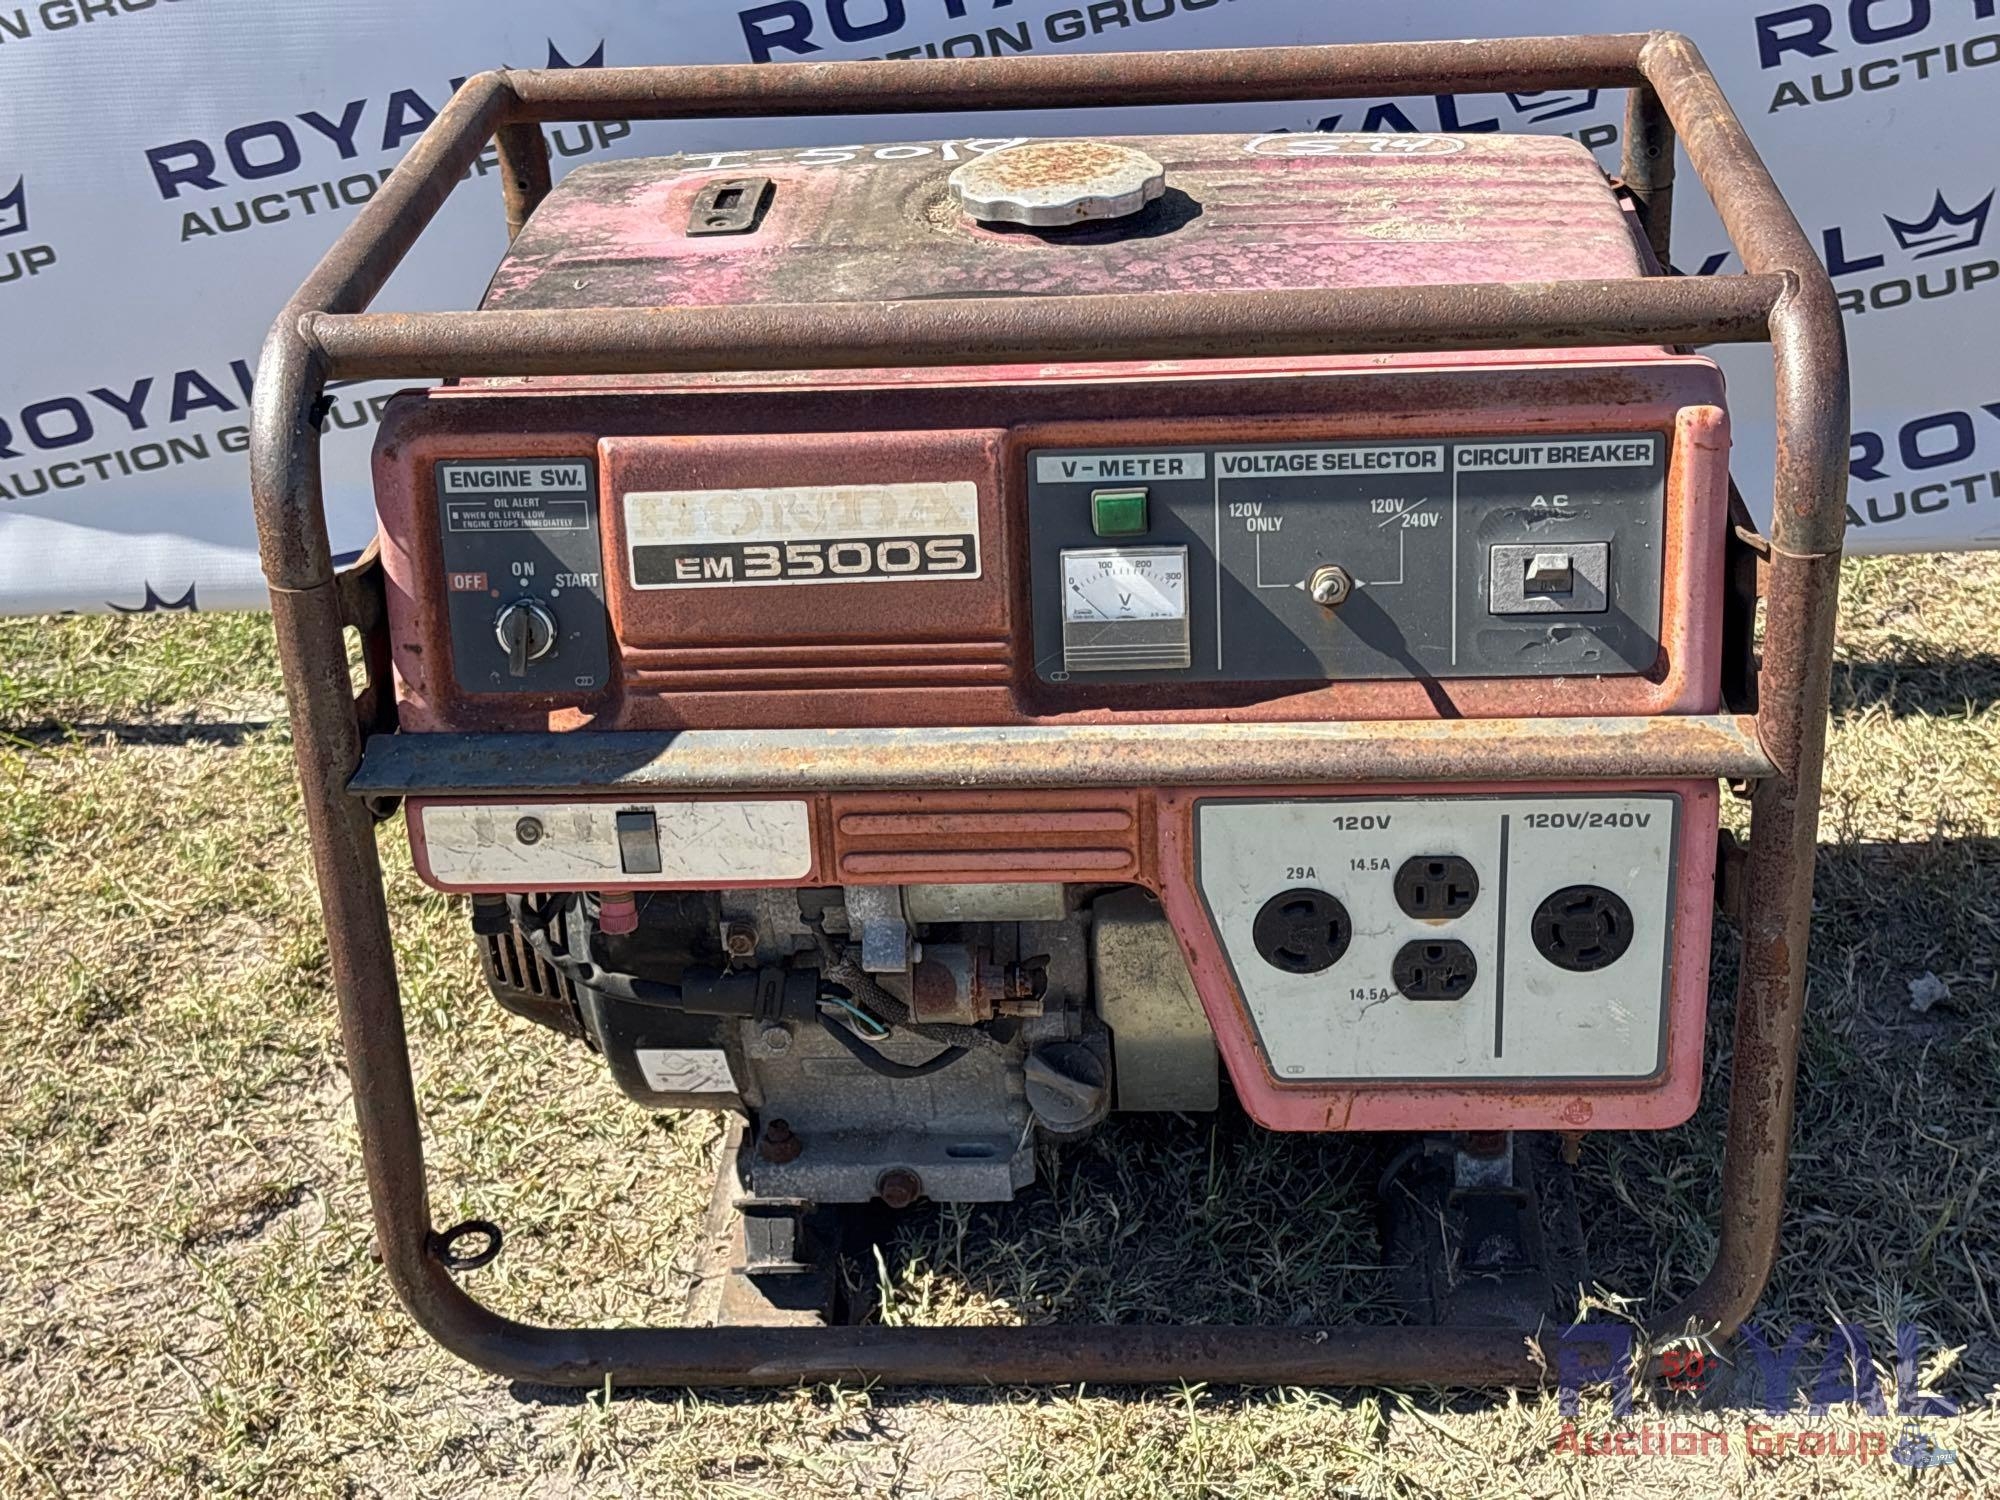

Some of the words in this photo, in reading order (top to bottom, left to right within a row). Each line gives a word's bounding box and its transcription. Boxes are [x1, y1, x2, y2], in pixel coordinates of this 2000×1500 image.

[145, 77, 468, 200] ROYA
[180, 168, 392, 242] AUCTIO
[1222, 454, 1318, 474] VOLTAGE
[1322, 450, 1437, 472] SELECTOR
[1457, 447, 1541, 467] CIRCUIT
[1546, 443, 1650, 463] BREAKER
[449, 470, 532, 488] ENGINE
[541, 469, 582, 486] SW.
[494, 499, 509, 509] OIL
[512, 498, 540, 508] ALERT
[1228, 503, 1262, 517] 120V
[462, 511, 487, 519] WHEN
[503, 511, 525, 519] LEVEL
[463, 520, 491, 528] ENGINE
[494, 520, 519, 528] STOPS
[1246, 517, 1283, 532] ONLY
[511, 562, 535, 576] ON
[1098, 561, 1113, 569] 100
[1135, 560, 1151, 568] 200
[454, 574, 481, 589] OFF
[555, 573, 599, 588] START
[1068, 577, 1075, 585] 0
[1165, 572, 1181, 580] 300
[1118, 593, 1132, 607] V
[1332, 815, 1391, 831] 120V
[1523, 811, 1651, 830] 120V/240V
[1349, 857, 1390, 872] 14.5A
[1286, 866, 1316, 880] 29A
[1349, 988, 1390, 1001] 14.5A
